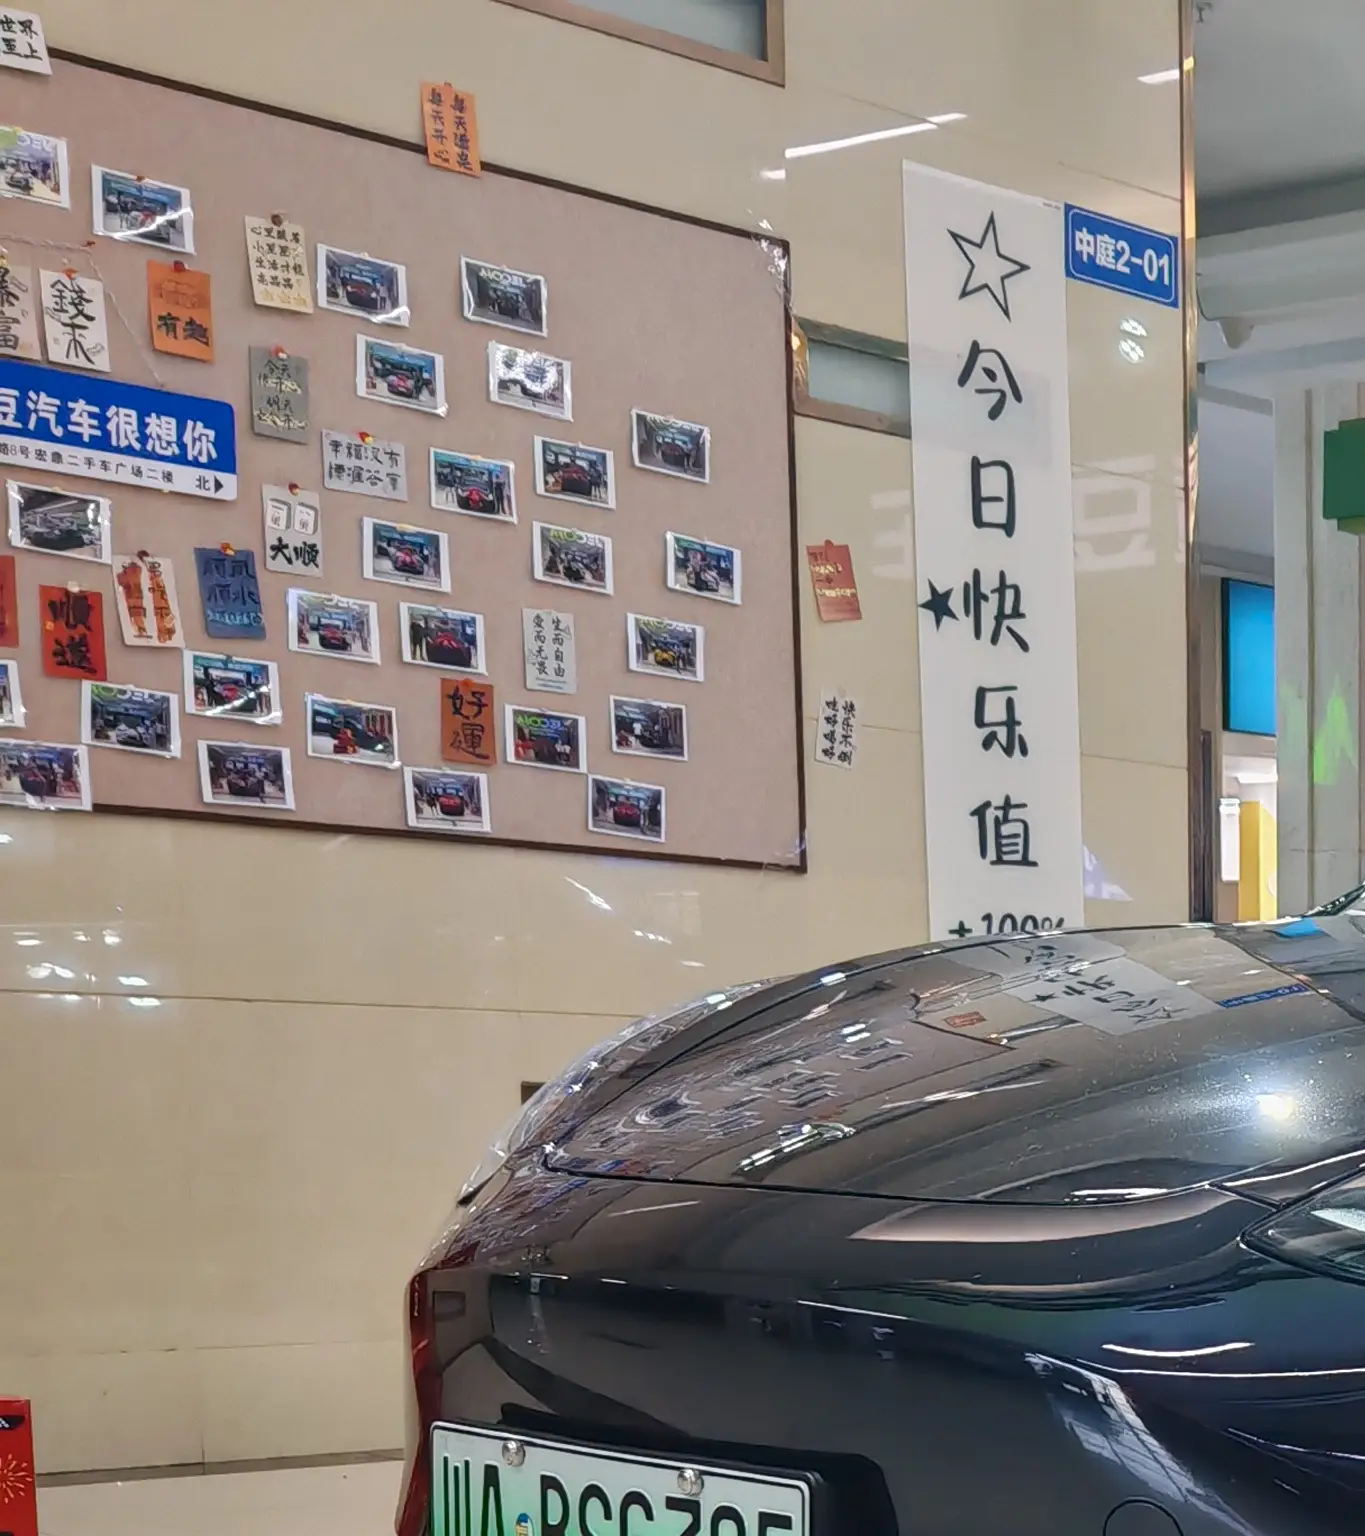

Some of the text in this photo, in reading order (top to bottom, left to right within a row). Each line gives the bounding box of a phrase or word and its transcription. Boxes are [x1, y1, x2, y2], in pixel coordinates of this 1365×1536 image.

[1074, 226, 1171, 288] 中庭2-01
[195, 475, 211, 492] 北
[957, 340, 1040, 868] 今日快乐值
